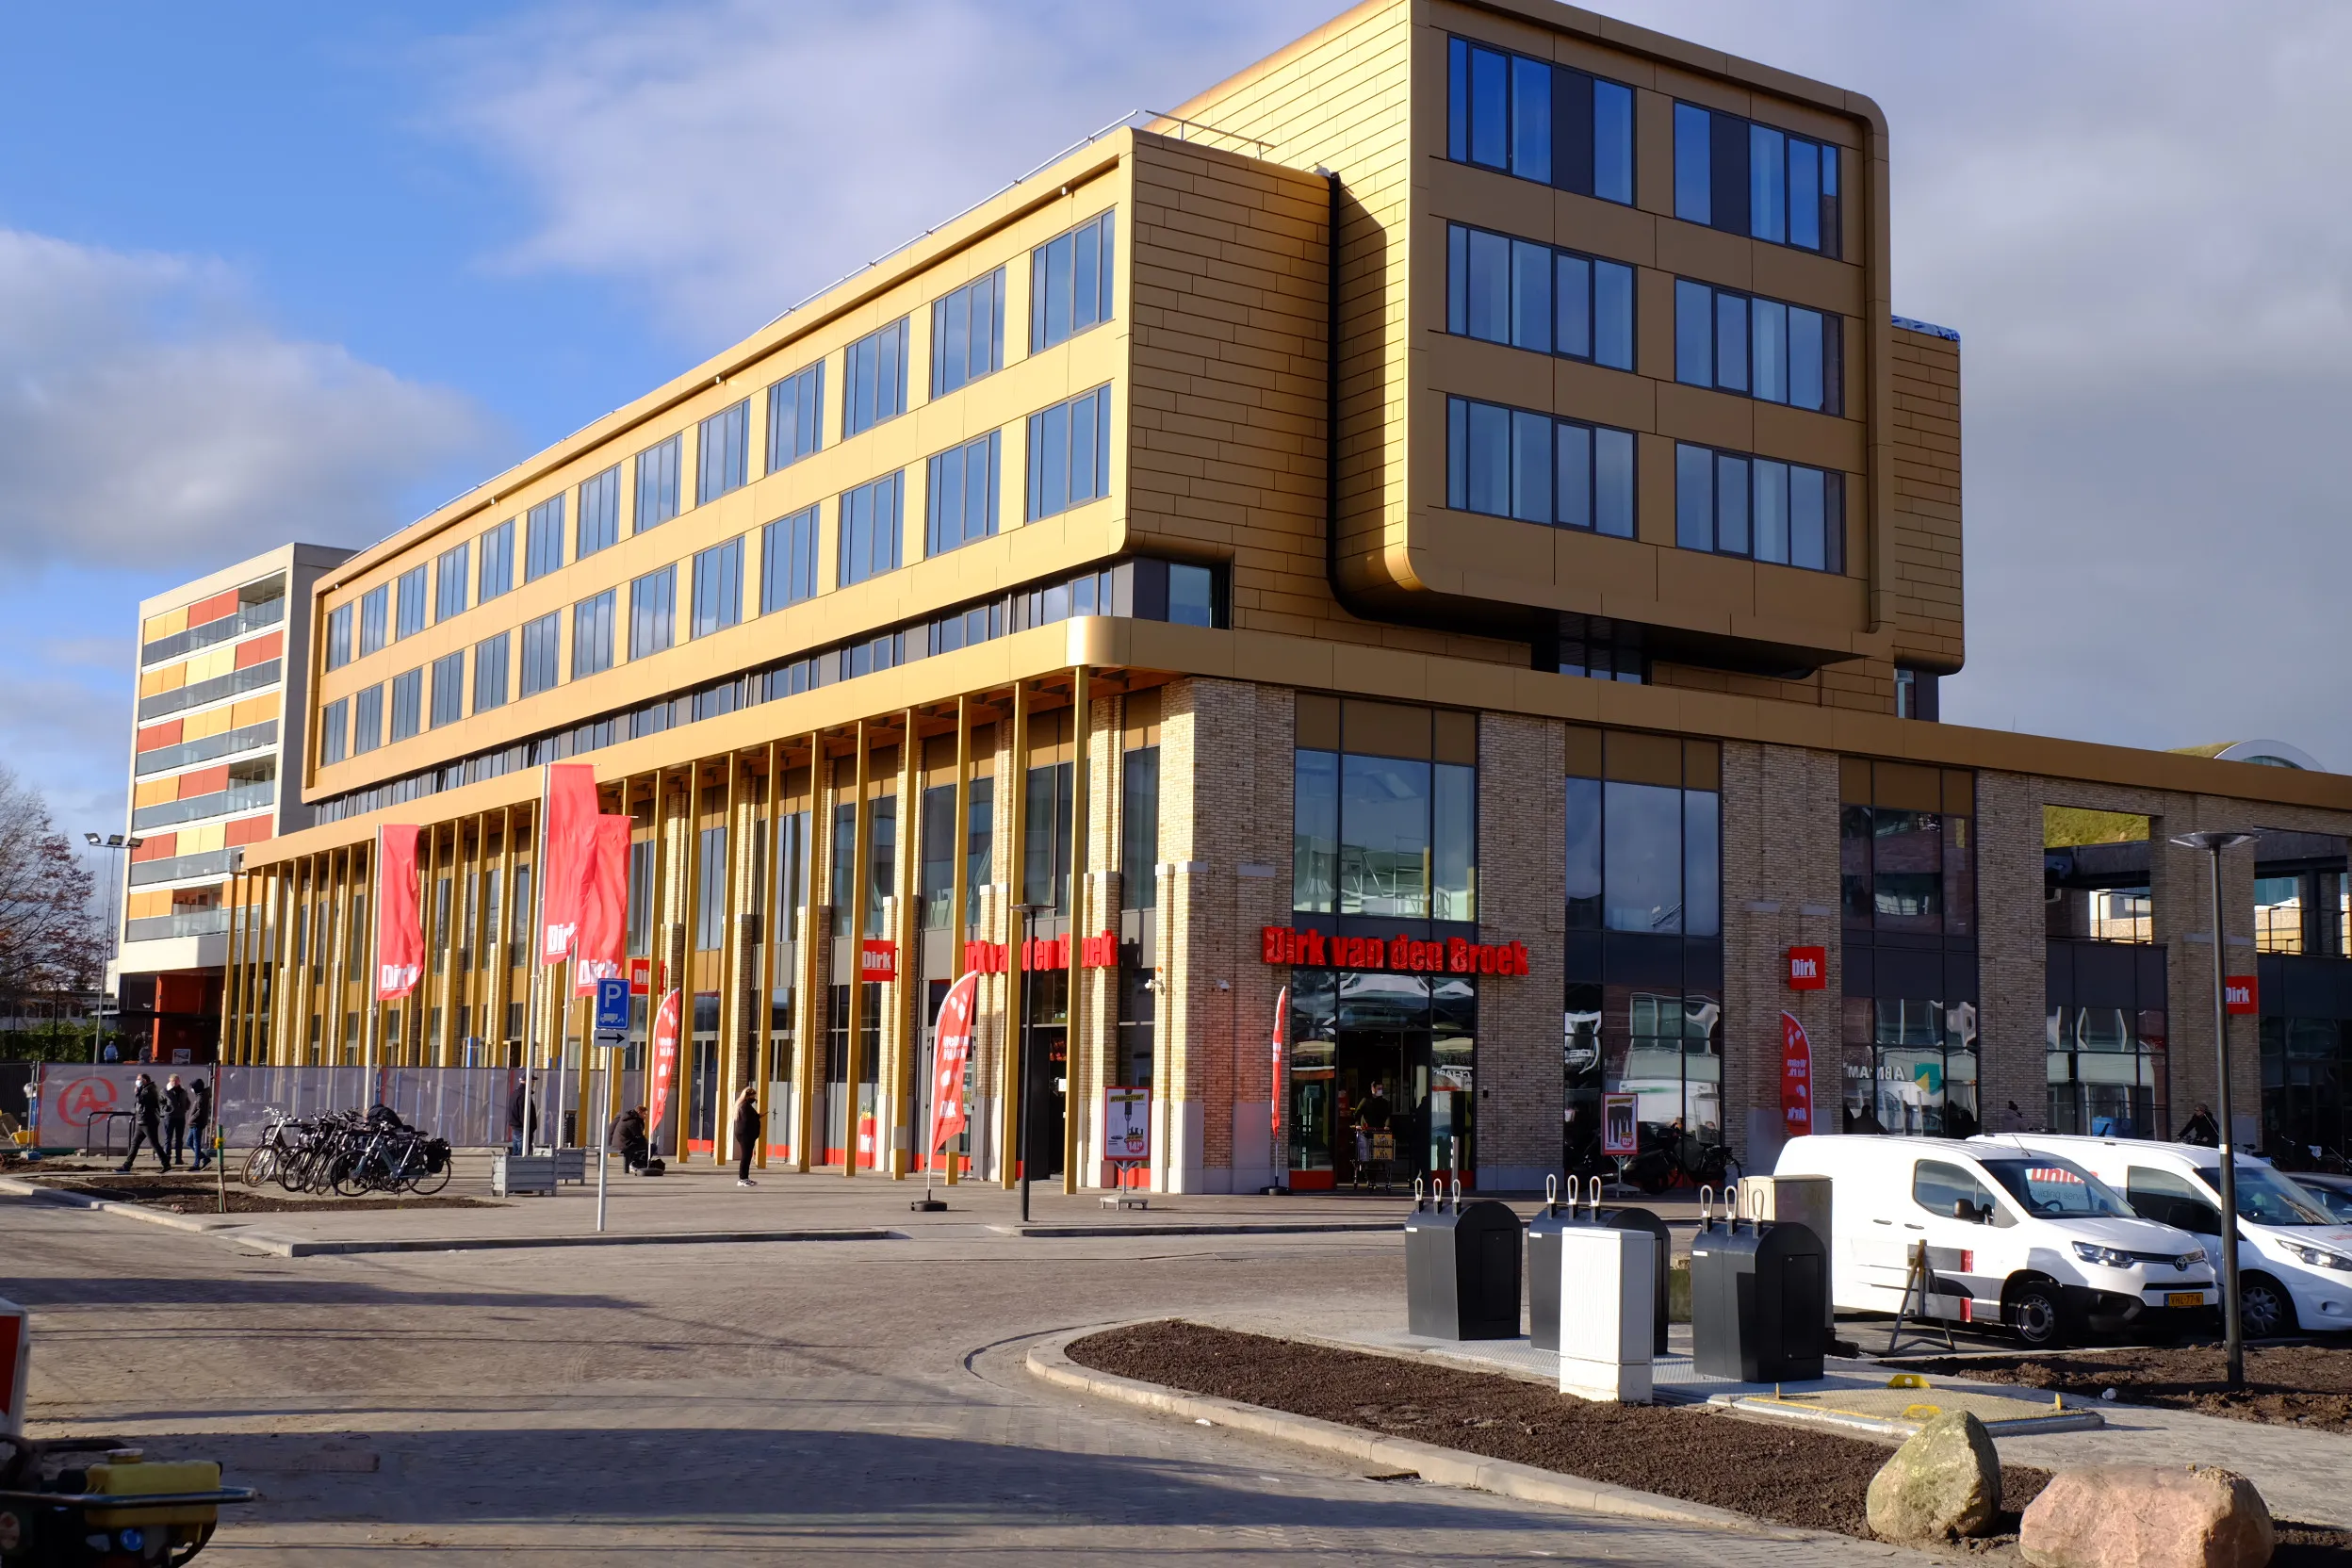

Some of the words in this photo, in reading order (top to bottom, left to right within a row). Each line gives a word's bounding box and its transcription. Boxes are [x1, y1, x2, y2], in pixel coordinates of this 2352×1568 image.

[862, 951, 891, 970] Dirk
[964, 939, 988, 973] irk
[988, 943, 1009, 973] va
[1058, 929, 1119, 969] Boek
[1263, 926, 1326, 966] Dirk
[1329, 936, 1384, 969] van
[1387, 934, 1444, 972] den
[1446, 937, 1530, 976] Broek
[381, 963, 417, 990] Dirk
[578, 959, 618, 986] Dirk
[634, 969, 649, 985] Di
[1791, 958, 1817, 978] Dirk
[605, 983, 622, 1008] P
[2225, 987, 2250, 1004] Dirk
[2031, 1168, 2099, 1185] unic
